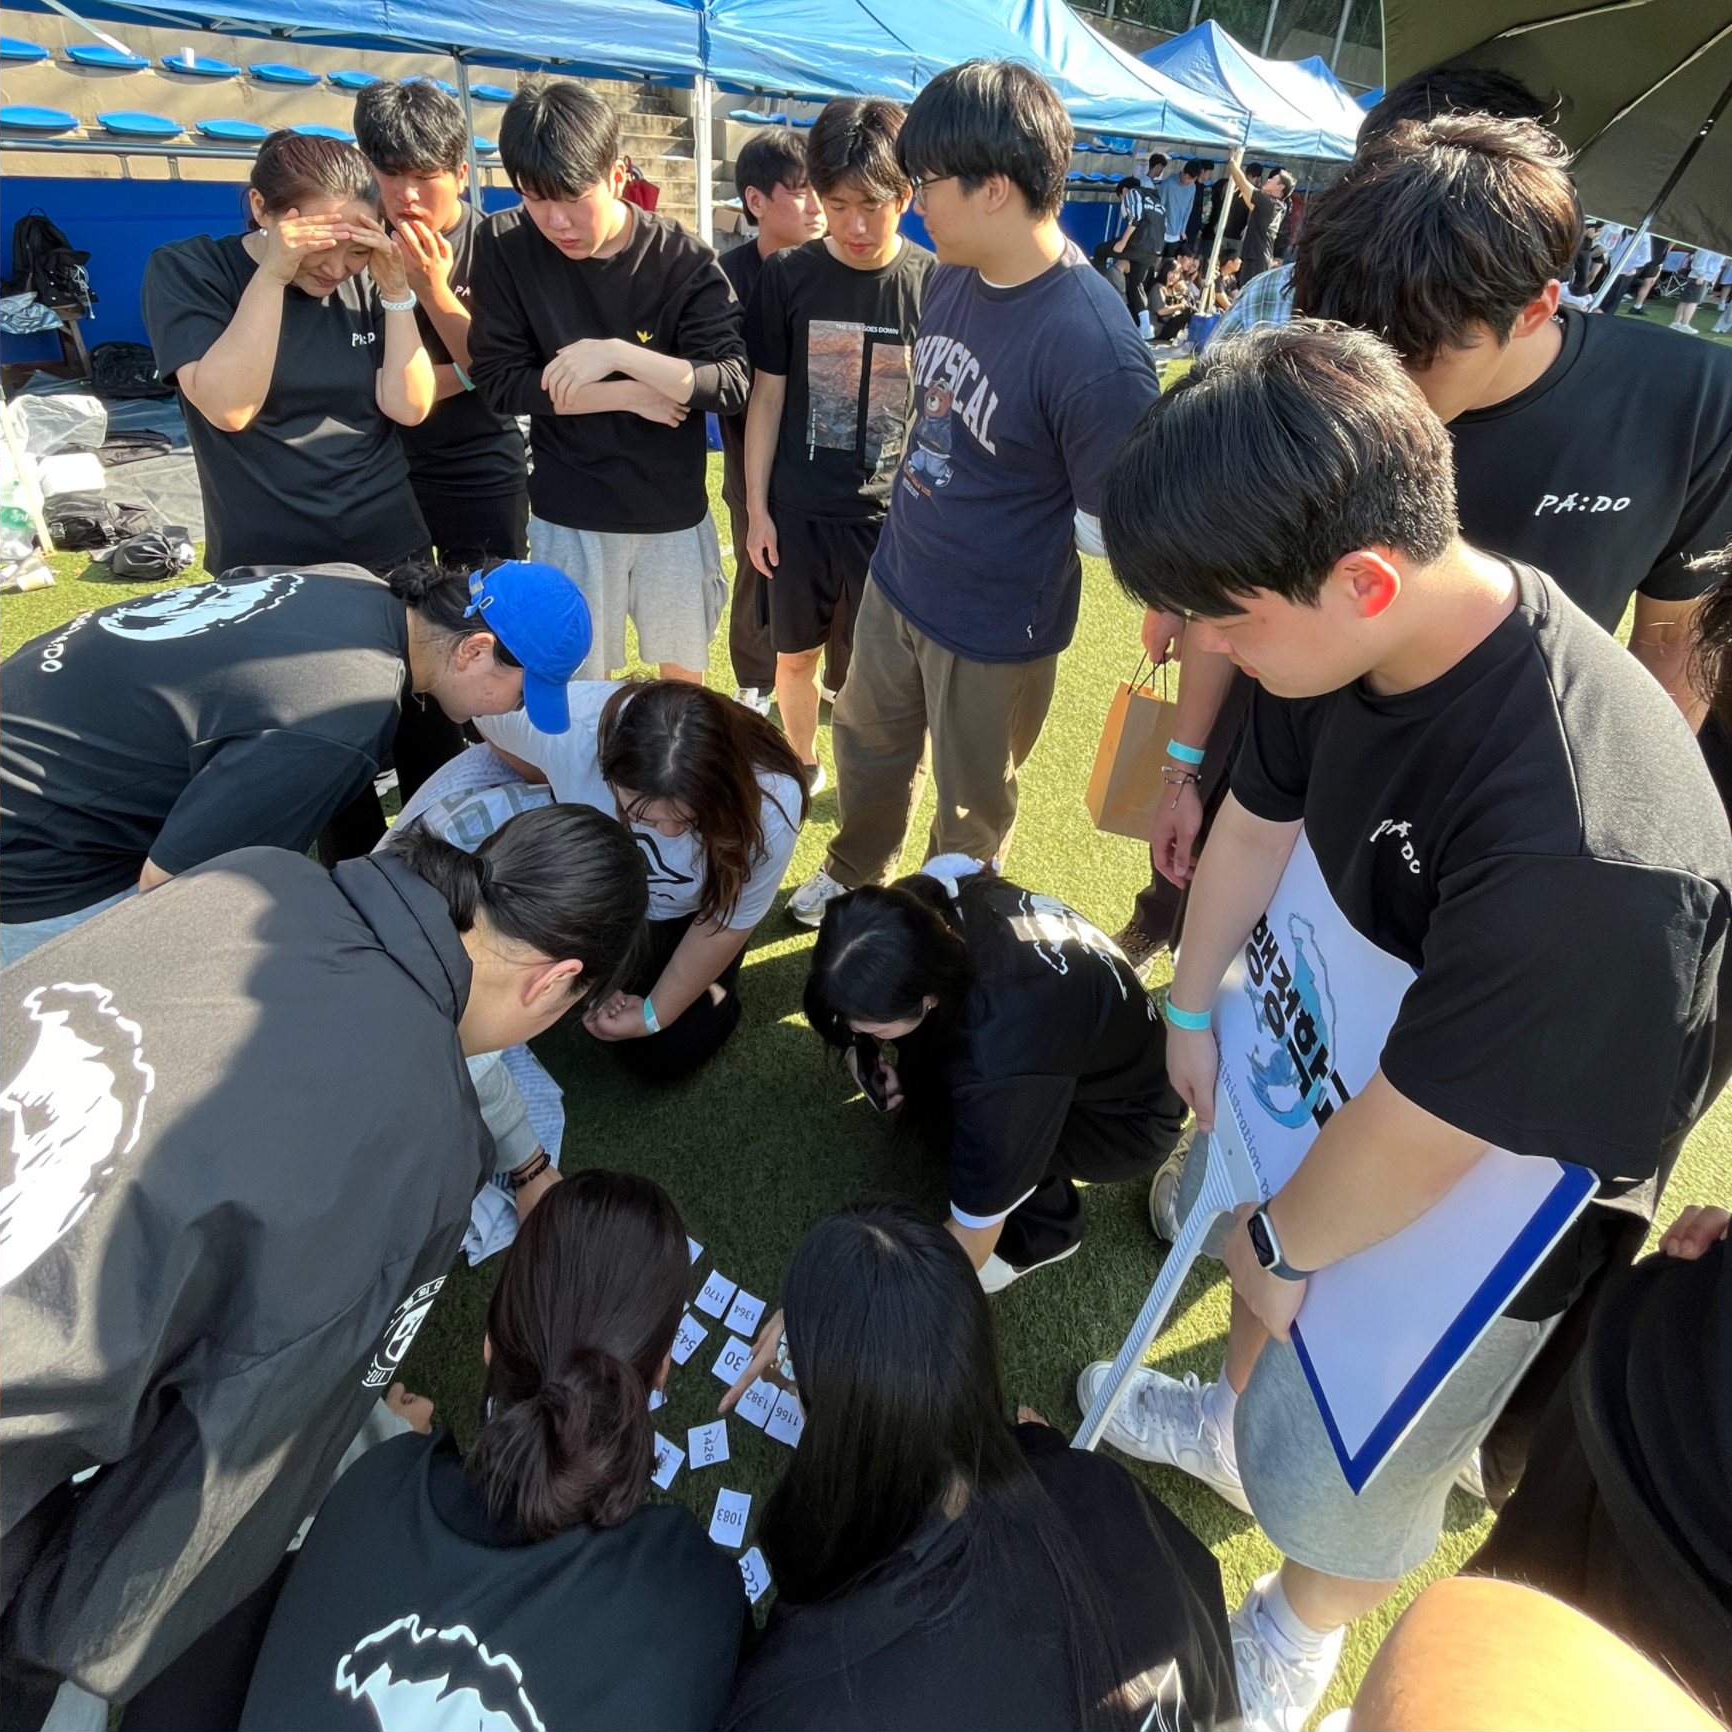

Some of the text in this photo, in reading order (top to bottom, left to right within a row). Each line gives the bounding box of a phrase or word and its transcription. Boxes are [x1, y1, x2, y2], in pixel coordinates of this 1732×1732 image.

[862, 325, 878, 333] GOES
[879, 327, 899, 335] DOWN
[1535, 494, 1631, 516] PA:DO
[704, 1285, 725, 1304] 1170
[733, 1304, 756, 1322] 1364
[724, 1351, 745, 1371] 30
[745, 1388, 768, 1410] 1382
[774, 1407, 799, 1427] 1166
[702, 1429, 715, 1462] 1426
[717, 1508, 743, 1526] 1083
[740, 1560, 759, 1595] 222
